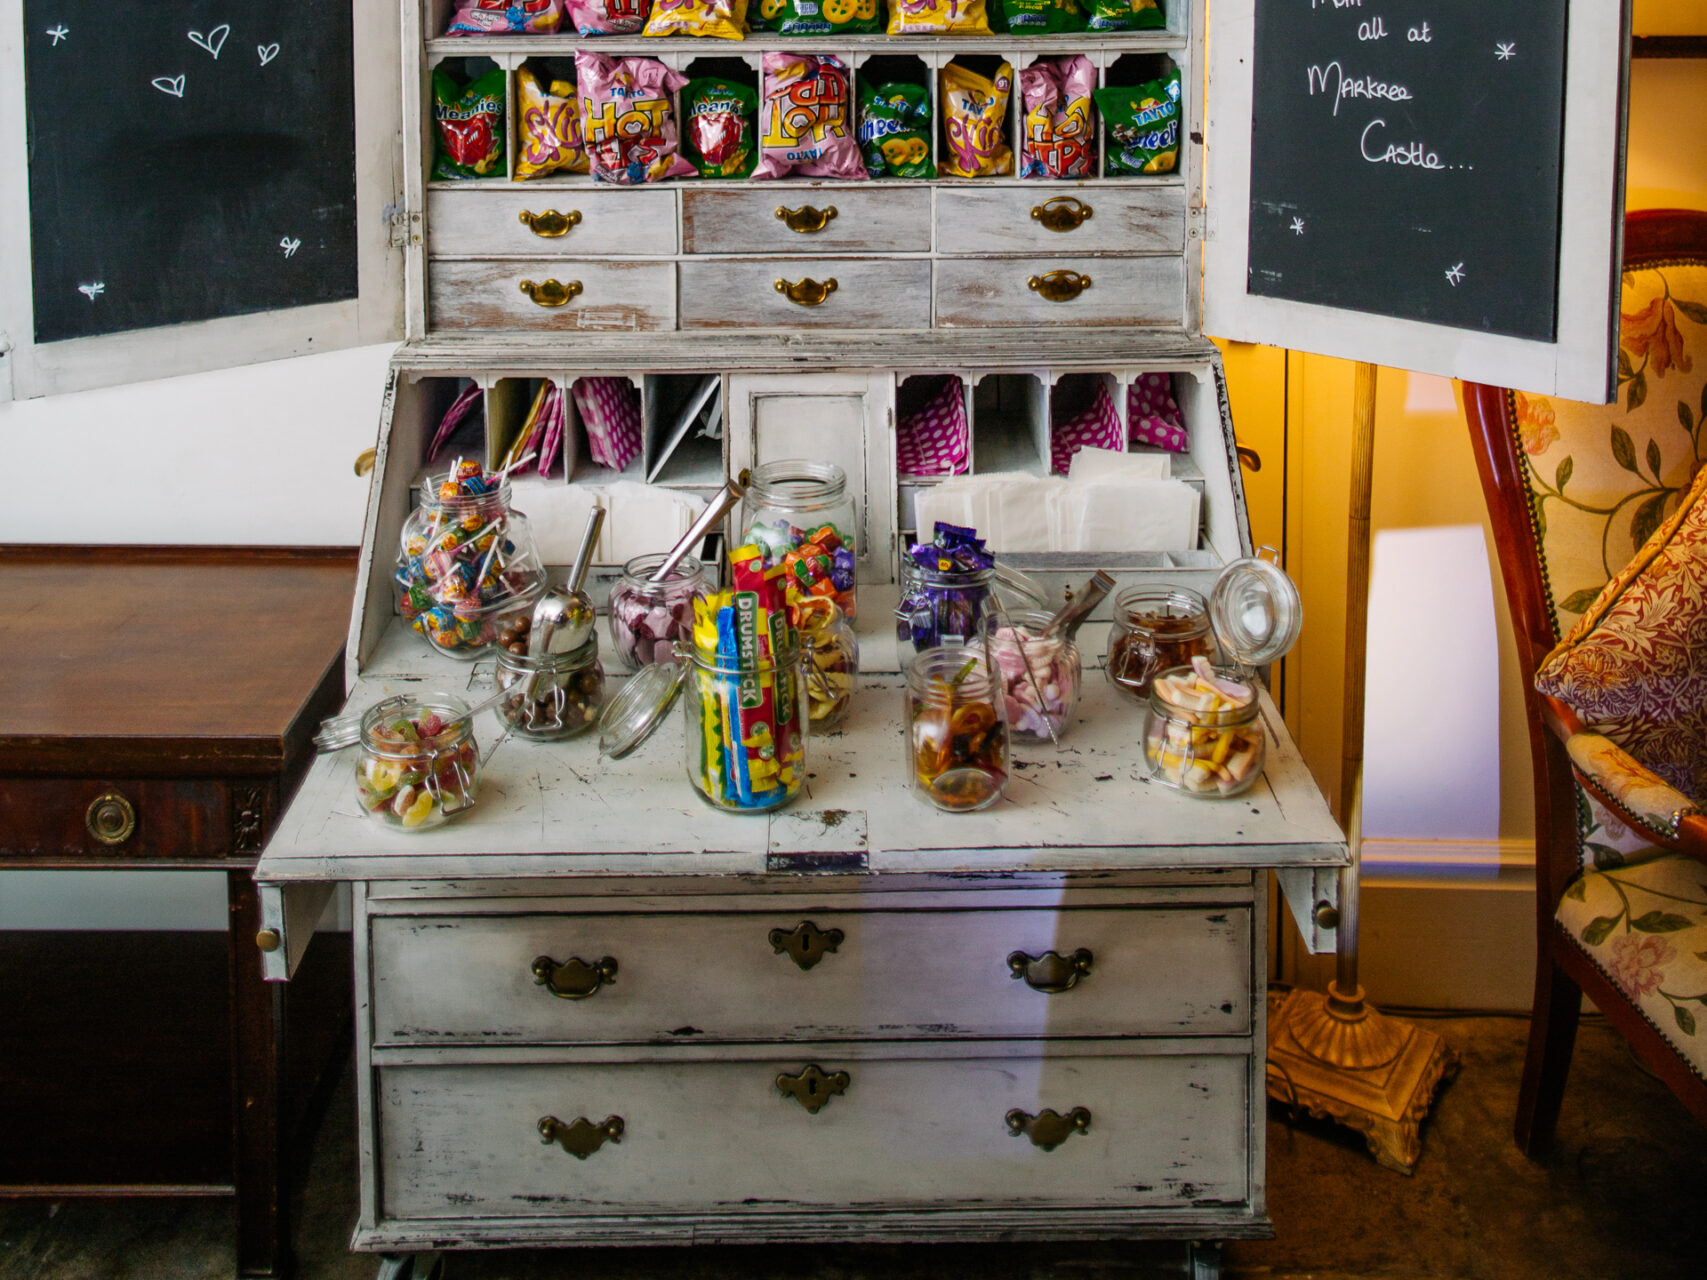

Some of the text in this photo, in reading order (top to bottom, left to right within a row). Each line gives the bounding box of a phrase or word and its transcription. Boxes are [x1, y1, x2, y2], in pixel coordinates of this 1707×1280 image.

[1358, 17, 1432, 42] all at
[584, 97, 669, 144] HOT
[762, 99, 846, 148] HOT
[1131, 100, 1176, 127] TAYTO
